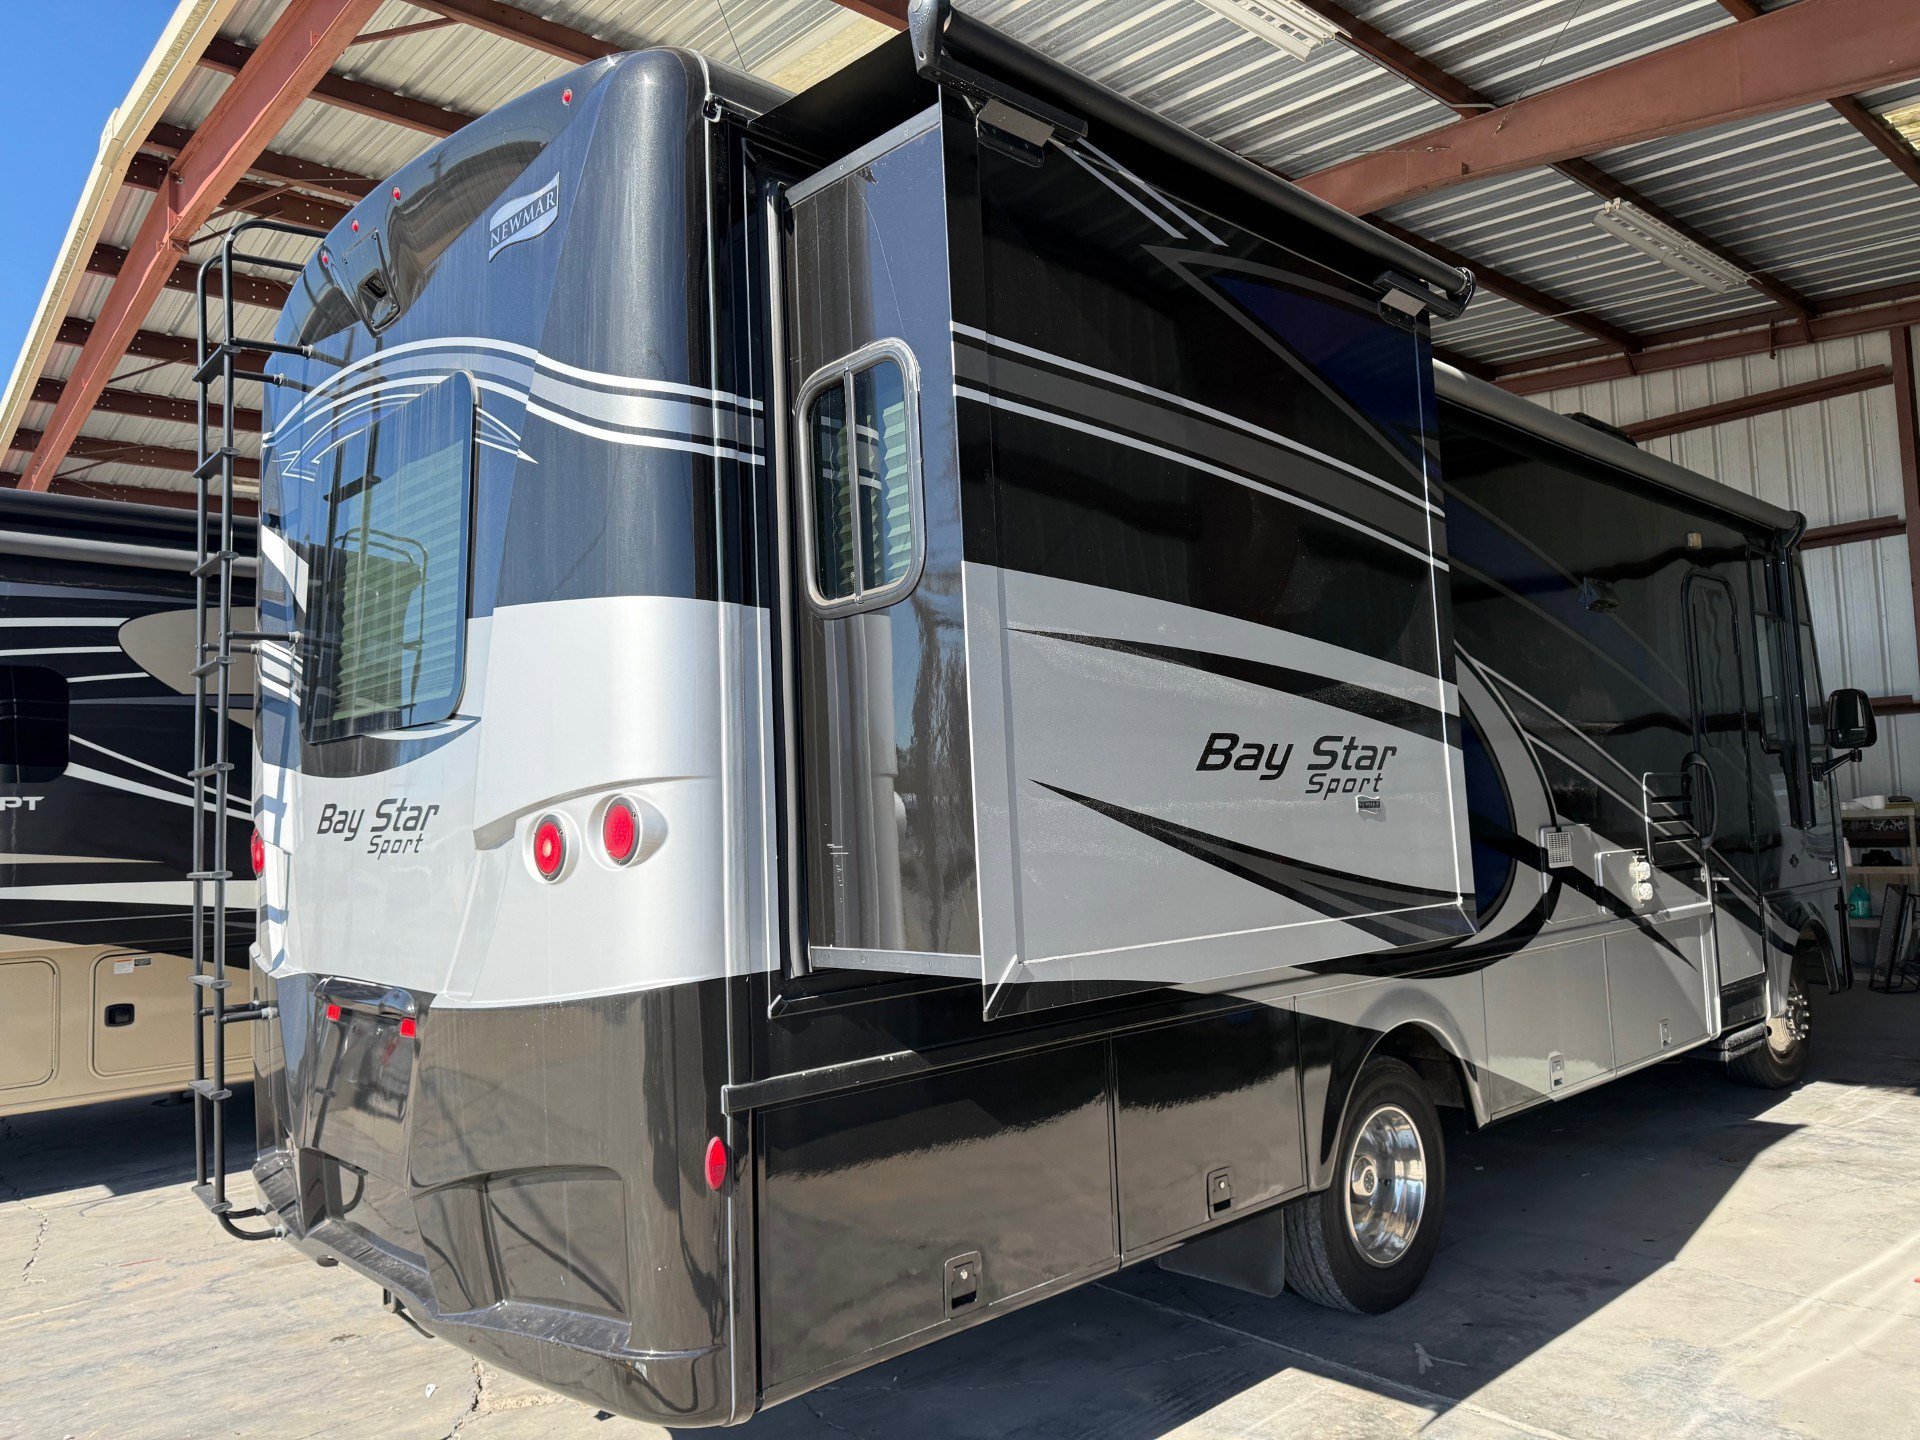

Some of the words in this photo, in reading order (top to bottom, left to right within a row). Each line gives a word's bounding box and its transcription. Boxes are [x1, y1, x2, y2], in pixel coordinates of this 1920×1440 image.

[490, 191, 556, 248] NEWMAR
[1195, 732, 1294, 781] Bay
[1306, 735, 1398, 771] Star
[1304, 772, 1384, 800] Sport
[316, 803, 365, 842] Bay
[370, 797, 440, 832] Star
[366, 833, 424, 860] Sport
